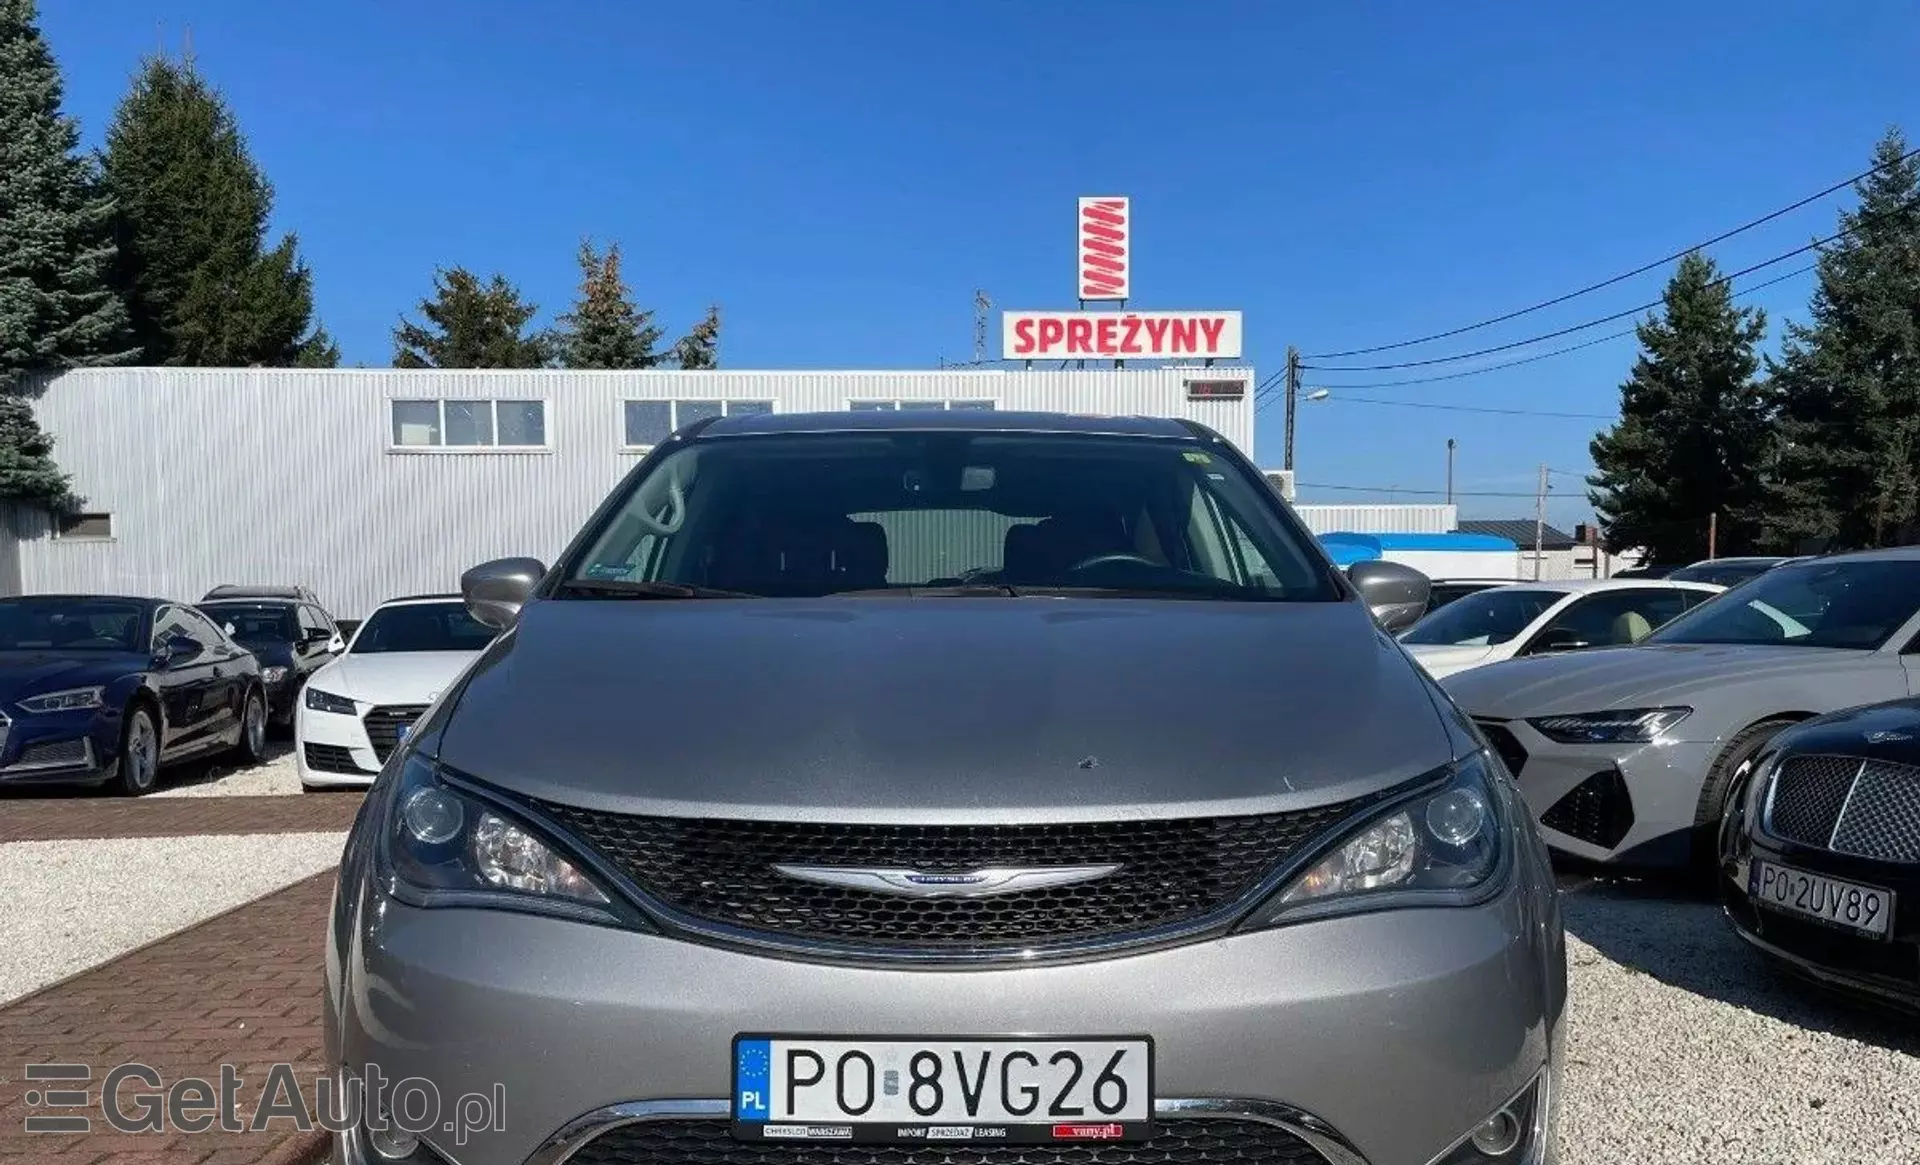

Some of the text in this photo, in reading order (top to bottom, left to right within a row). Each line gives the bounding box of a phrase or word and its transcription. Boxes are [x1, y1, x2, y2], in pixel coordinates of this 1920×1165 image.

[1763, 866, 1789, 901] PO
[1795, 876, 1880, 926] 2UV89
[742, 1091, 766, 1110] PL
[786, 1049, 1128, 1117] PO 8VG26
[897, 1128, 926, 1137] IMPORT
[974, 1128, 1006, 1137] LEASING
